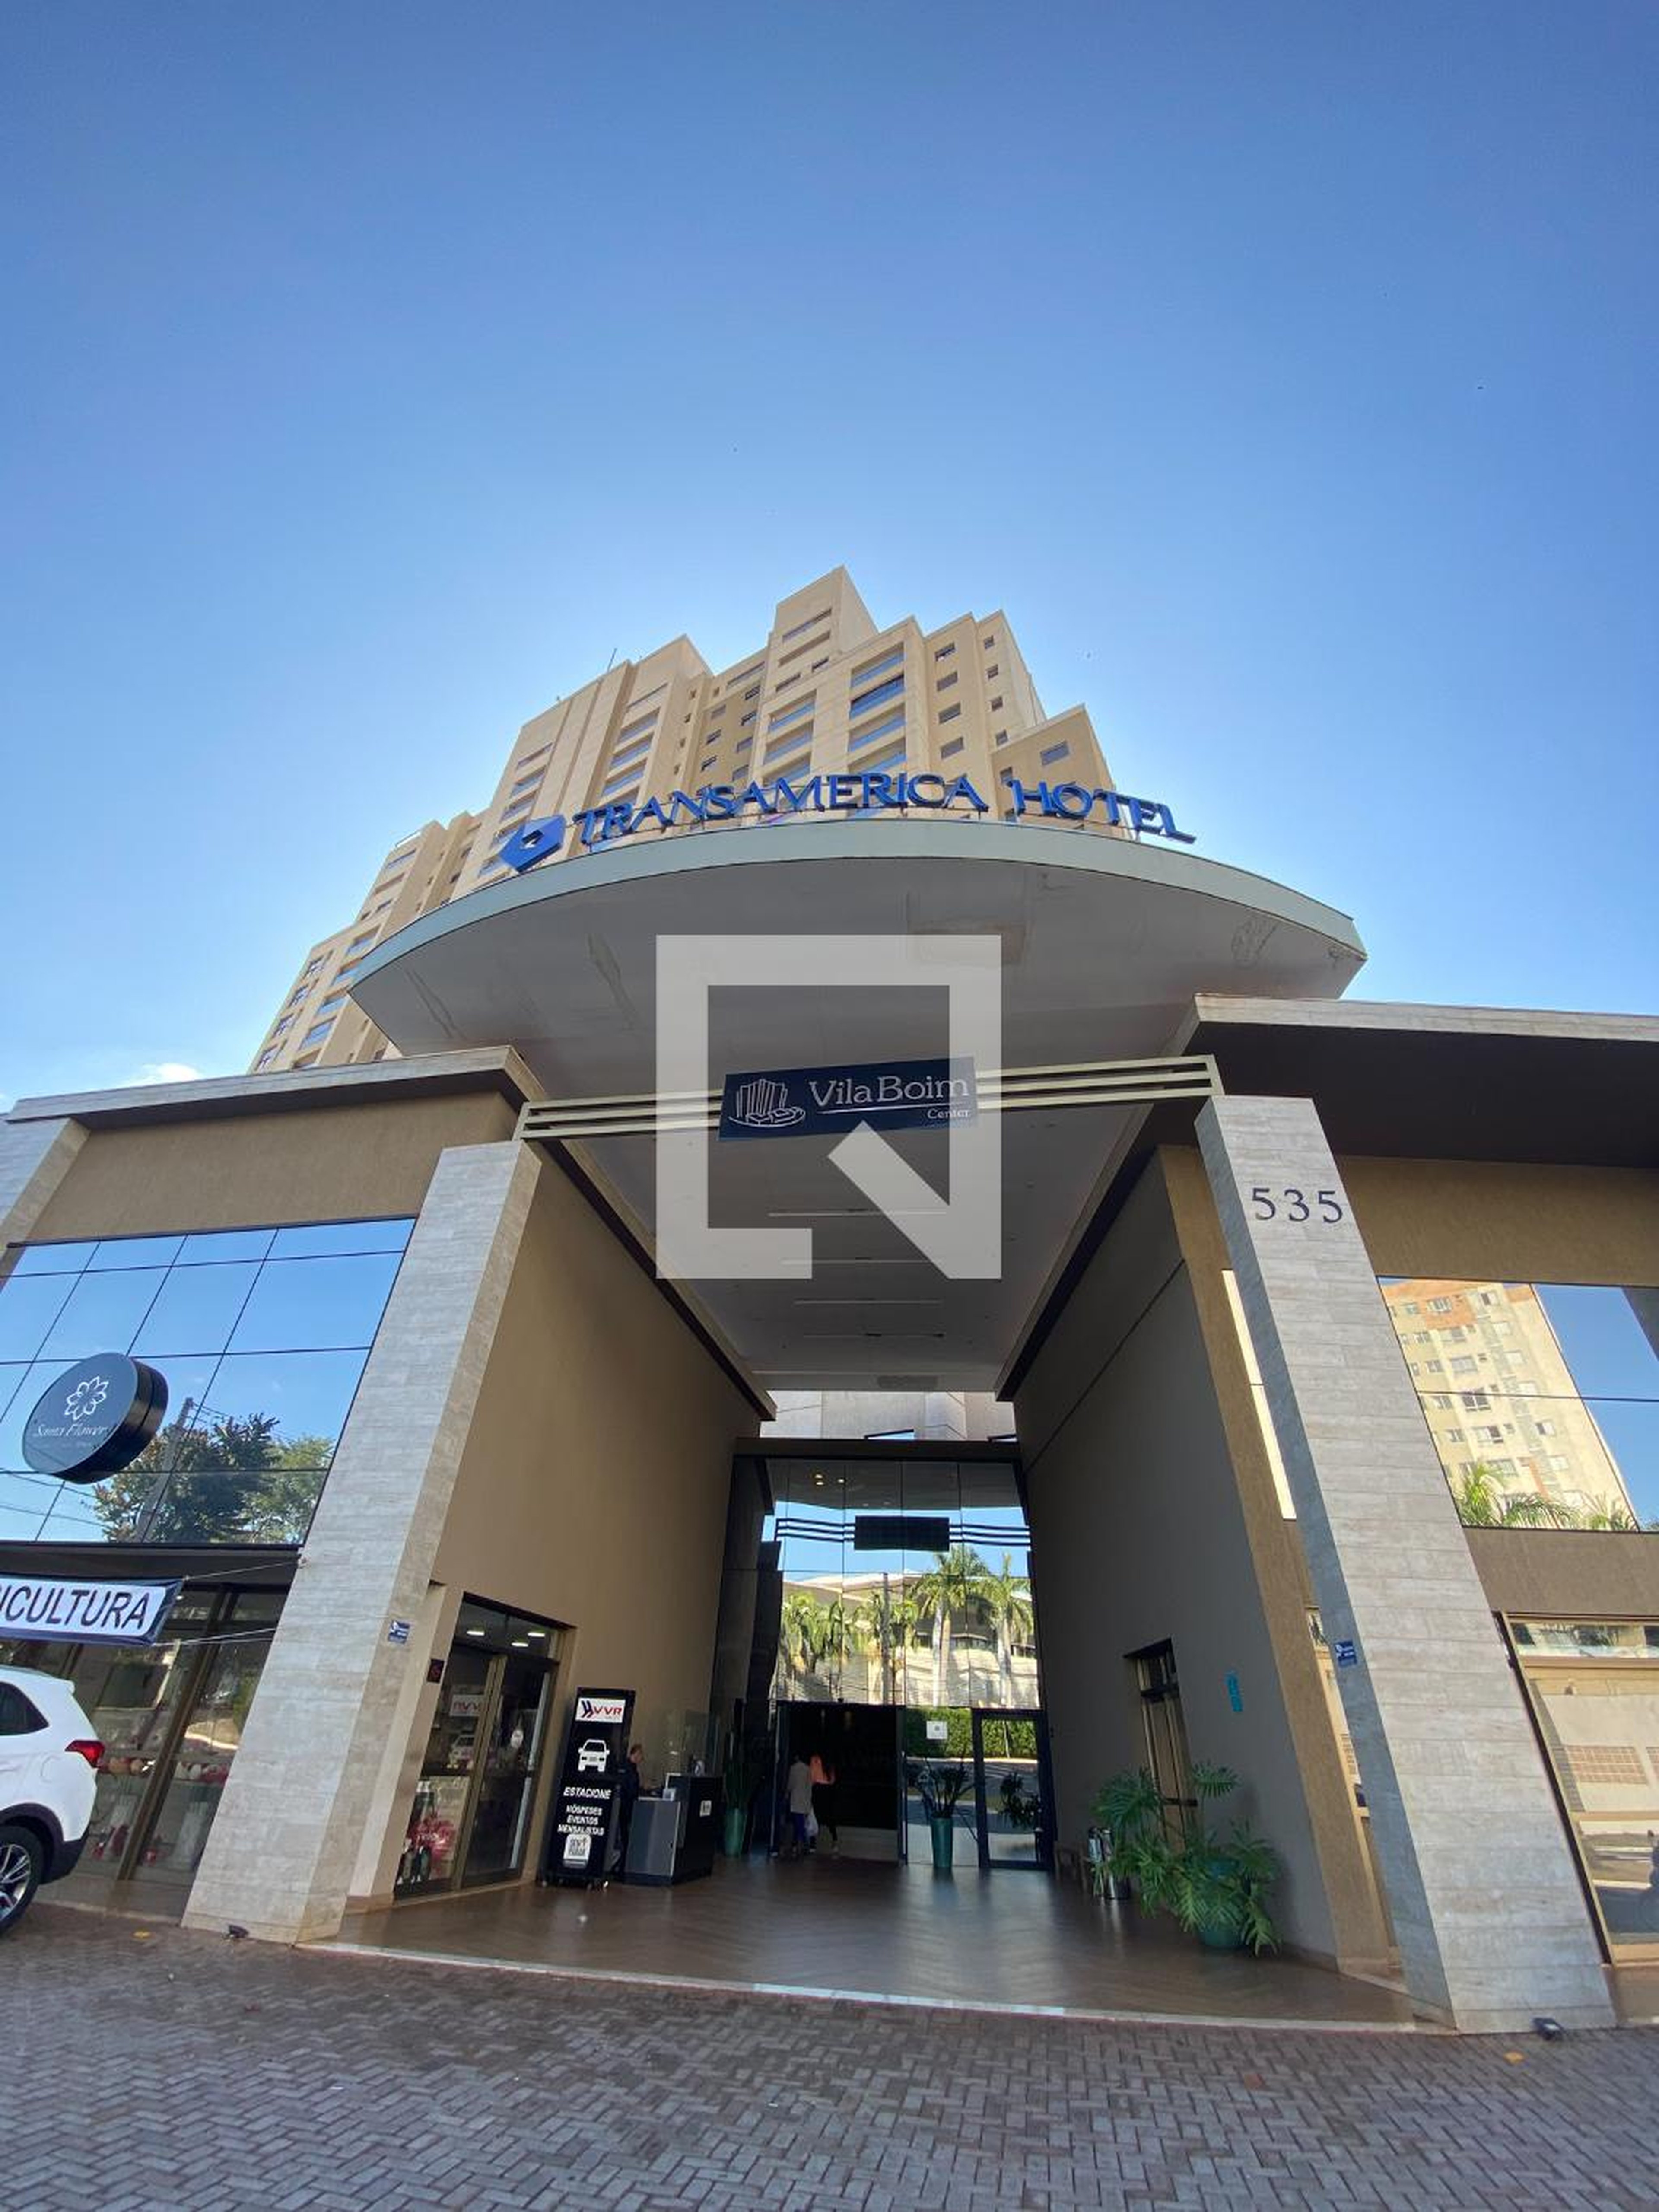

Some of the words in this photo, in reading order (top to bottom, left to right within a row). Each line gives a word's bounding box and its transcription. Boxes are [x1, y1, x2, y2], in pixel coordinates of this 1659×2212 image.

[572, 772, 988, 846] TRANSAMERICA
[1004, 778, 1196, 844] HOTEL
[927, 1107, 970, 1120] Center
[1252, 1187, 1343, 1223] 535
[0, 1585, 150, 1629] ICULTURA
[563, 1786, 612, 1800] ESTACIONE
